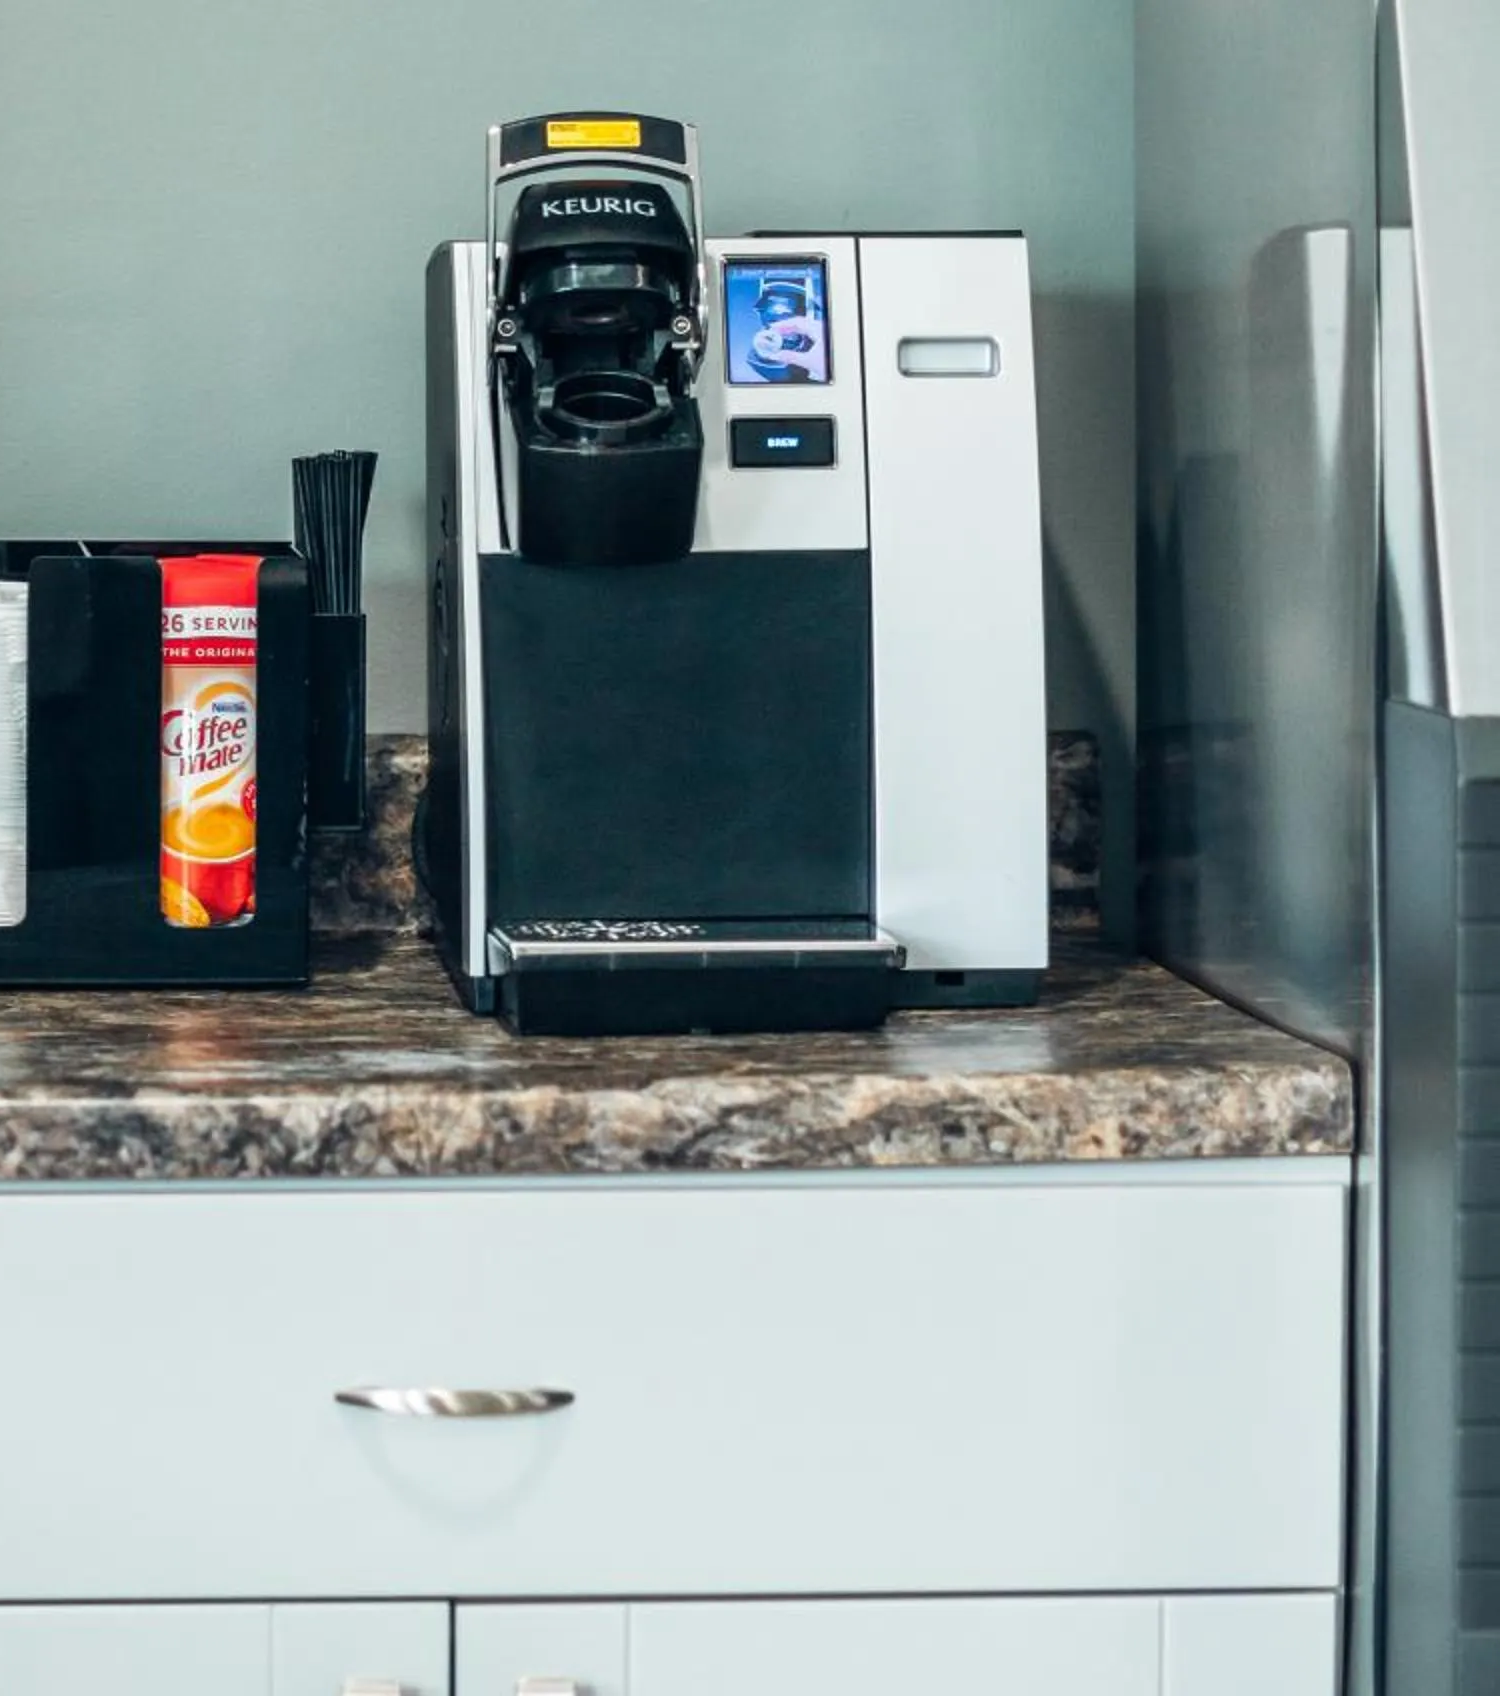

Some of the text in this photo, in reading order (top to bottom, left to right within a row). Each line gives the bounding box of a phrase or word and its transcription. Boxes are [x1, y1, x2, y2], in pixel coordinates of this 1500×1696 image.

[542, 197, 656, 217] KEURIG
[162, 614, 184, 633] 26
[163, 647, 190, 657] THE
